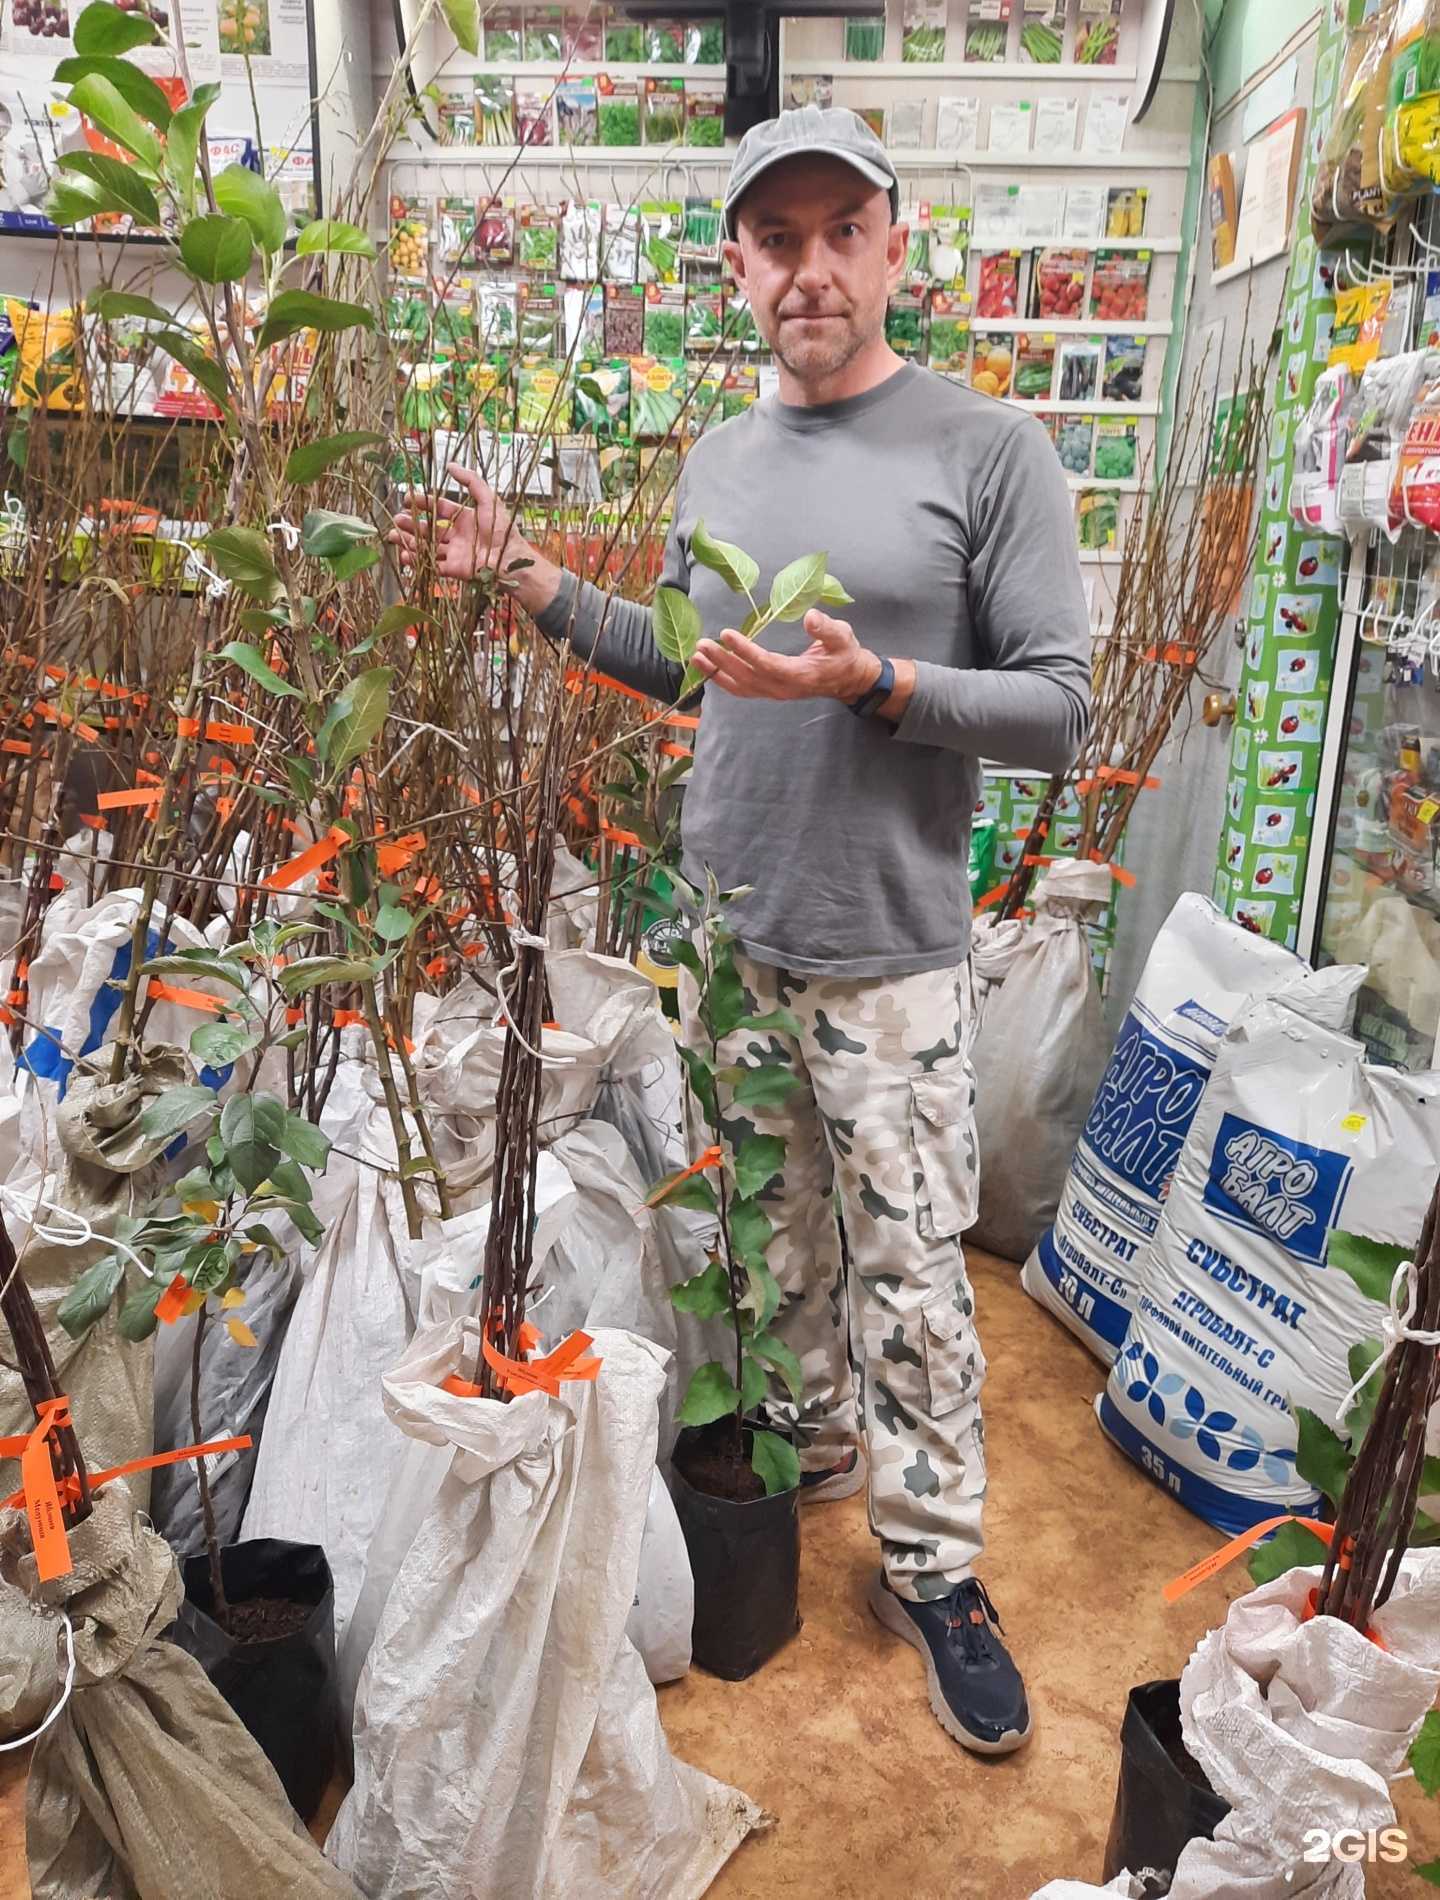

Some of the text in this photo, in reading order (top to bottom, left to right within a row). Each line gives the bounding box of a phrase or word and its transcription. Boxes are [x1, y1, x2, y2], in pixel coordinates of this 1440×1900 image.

[1107, 1032, 1206, 1124] АГРО
[1086, 1082, 1186, 1185] БАЛТ
[1225, 1130, 1318, 1197] АГРО
[1072, 1200, 1139, 1262] СУБСТРАТ
[1222, 1167, 1316, 1240] БАЛТ
[1186, 1238, 1307, 1330] СУБСТРАТ
[1139, 1295, 1292, 1415] ТОРФЯНОЙ ПИТАТЕЛЬНЫЙ ГРУ
[1172, 1290, 1275, 1369] АГРОБАЛТ-С
[1141, 1445, 1166, 1481] 35
